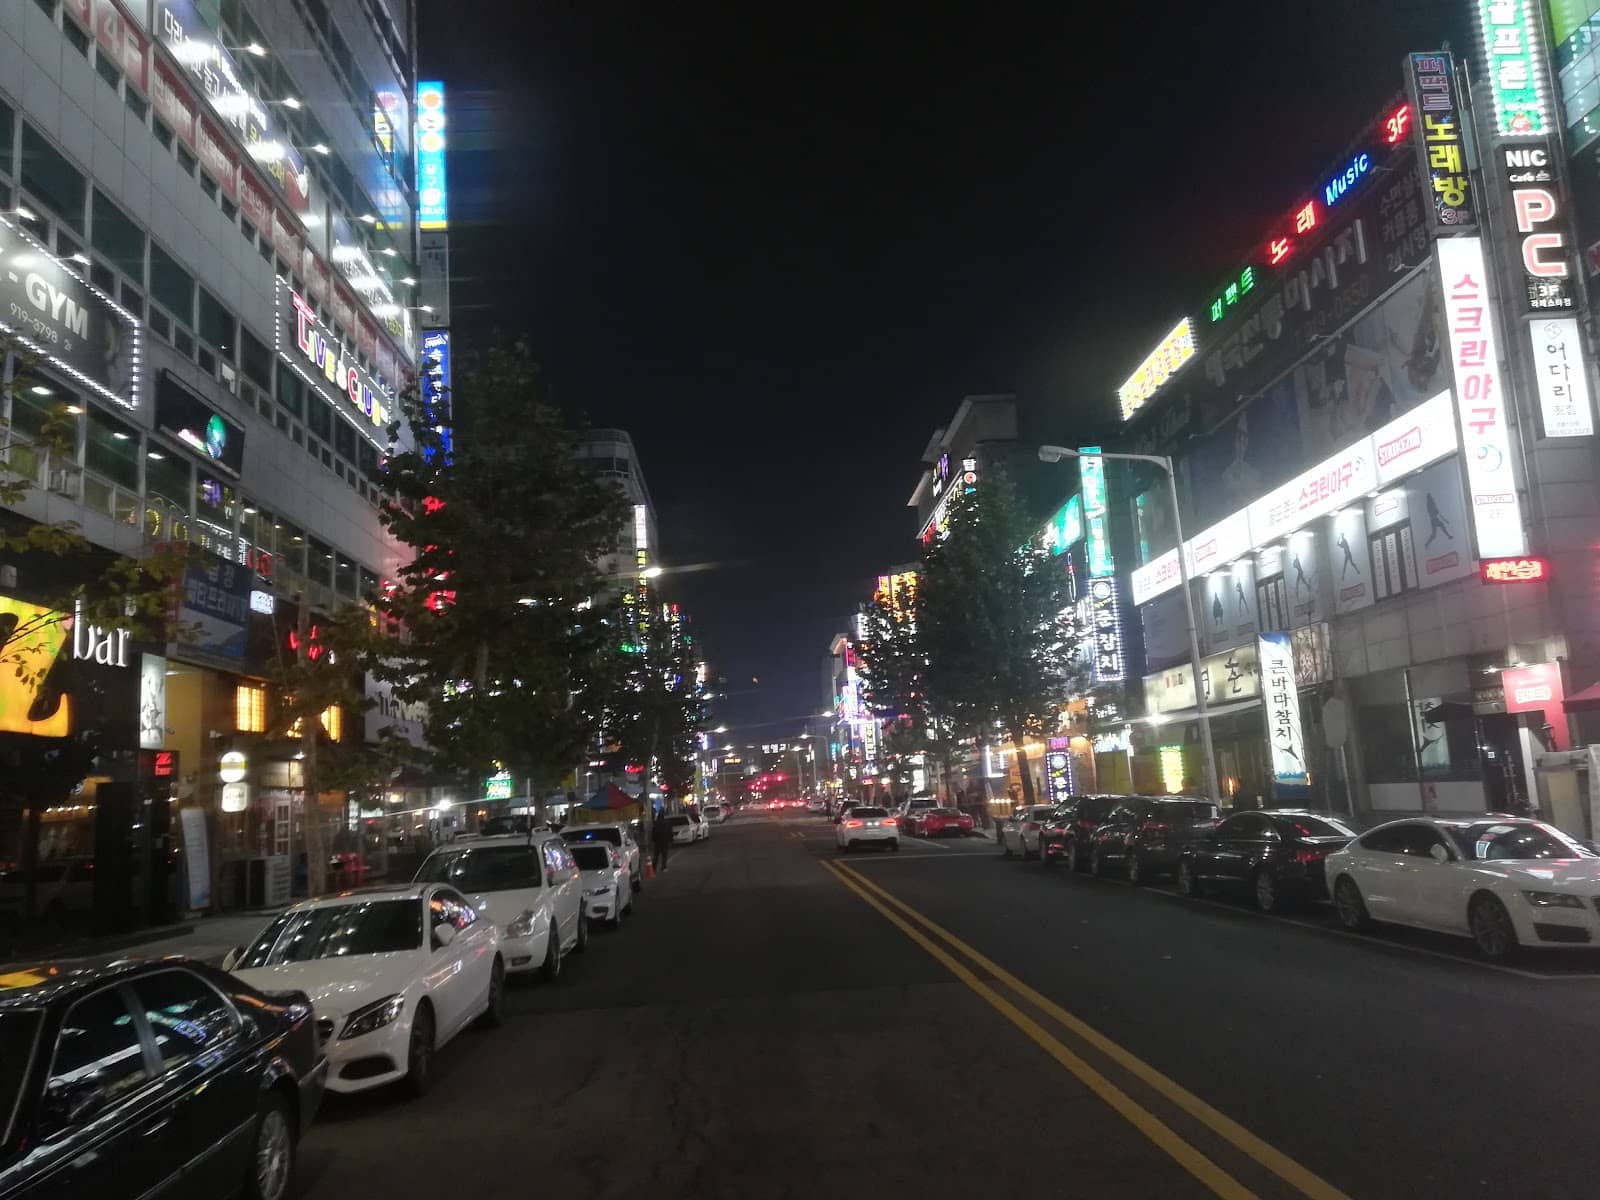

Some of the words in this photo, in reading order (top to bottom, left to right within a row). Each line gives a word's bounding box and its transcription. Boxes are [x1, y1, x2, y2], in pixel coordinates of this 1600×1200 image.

[1387, 105, 1409, 142] 3F
[1326, 154, 1368, 205] Music
[1424, 114, 1468, 207] 노래방
[1505, 150, 1547, 167] NIC
[1513, 189, 1568, 277] PC
[25, 272, 88, 340] GYM
[1538, 285, 1559, 297] 3F
[1451, 274, 1496, 434] 스크린야구
[1547, 342, 1572, 402] 어다리
[1299, 461, 1353, 511] 스크린야구
[73, 600, 132, 668] bar
